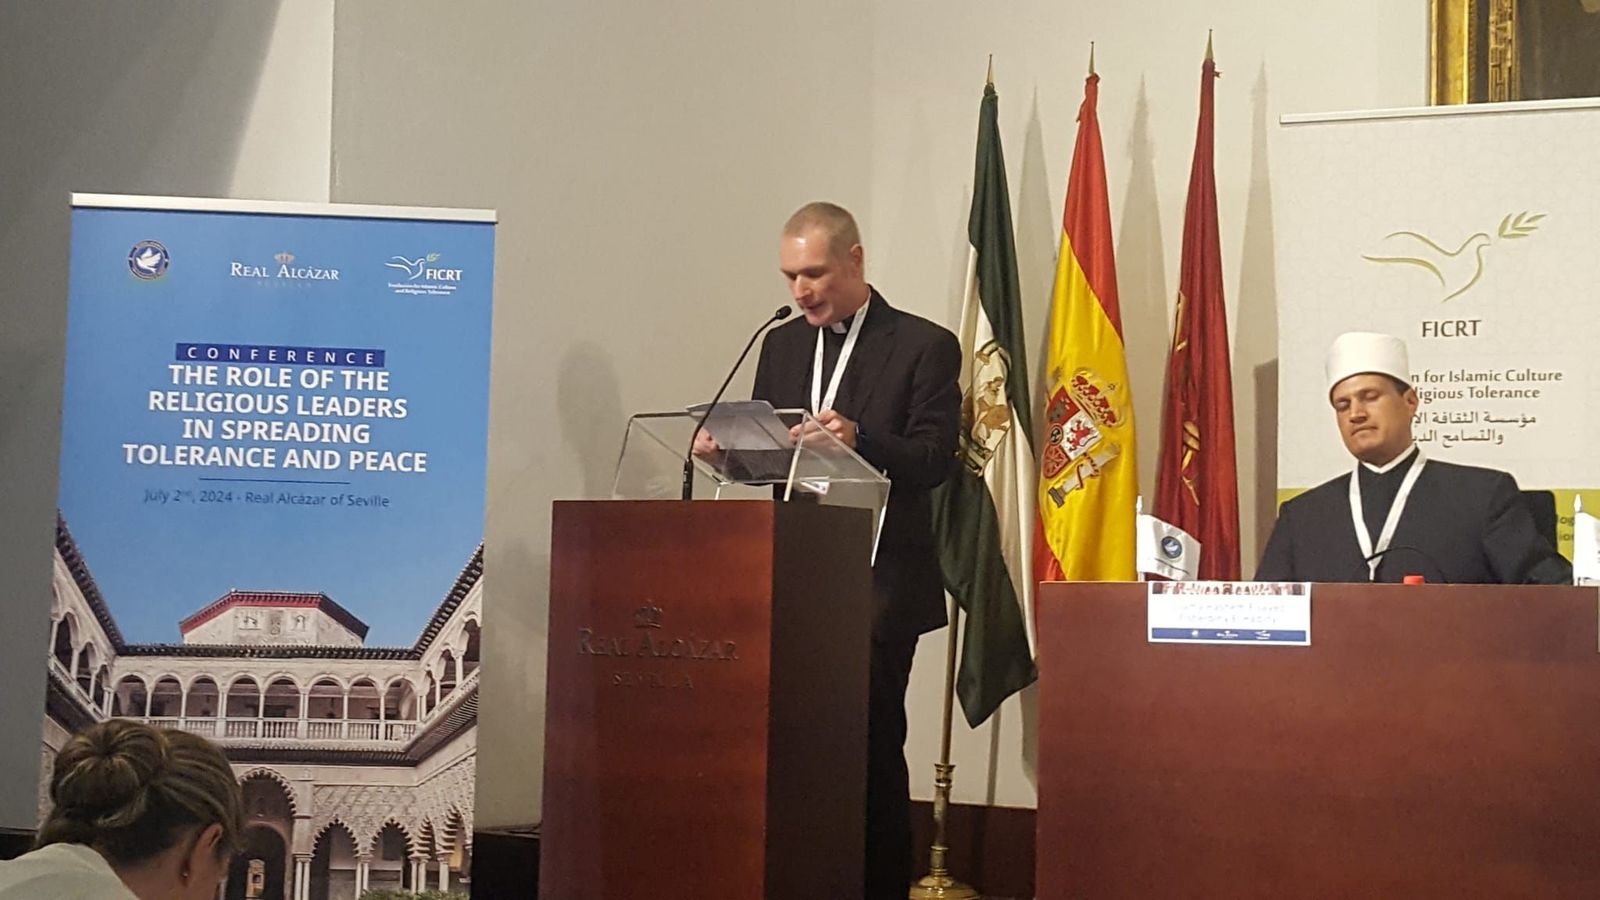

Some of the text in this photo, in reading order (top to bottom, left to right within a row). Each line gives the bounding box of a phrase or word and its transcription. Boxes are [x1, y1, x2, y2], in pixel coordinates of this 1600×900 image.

[426, 268, 463, 281] FICRT
[1421, 319, 1482, 338] FICRT
[187, 346, 374, 365] CONFERENCE
[168, 364, 390, 391] THE ROLE OF THE
[1424, 369, 1445, 383] for
[1449, 369, 1501, 382] Islamic
[1505, 368, 1563, 382] Culture
[1468, 385, 1541, 399] Tolerance
[148, 391, 408, 419] RELIGIOUS LEADERS
[1432, 411, 1479, 425] الثقافة
[1483, 411, 1537, 428] مؤسسة
[182, 418, 370, 444] IN SPREADING
[1442, 428, 1504, 448] والتسامح
[122, 443, 427, 473] TOLERANCE AND PEACE
[143, 489, 169, 504] July
[200, 490, 233, 503] 2024
[245, 491, 274, 504] Real
[330, 493, 346, 506] of
[347, 493, 390, 508] Seville
